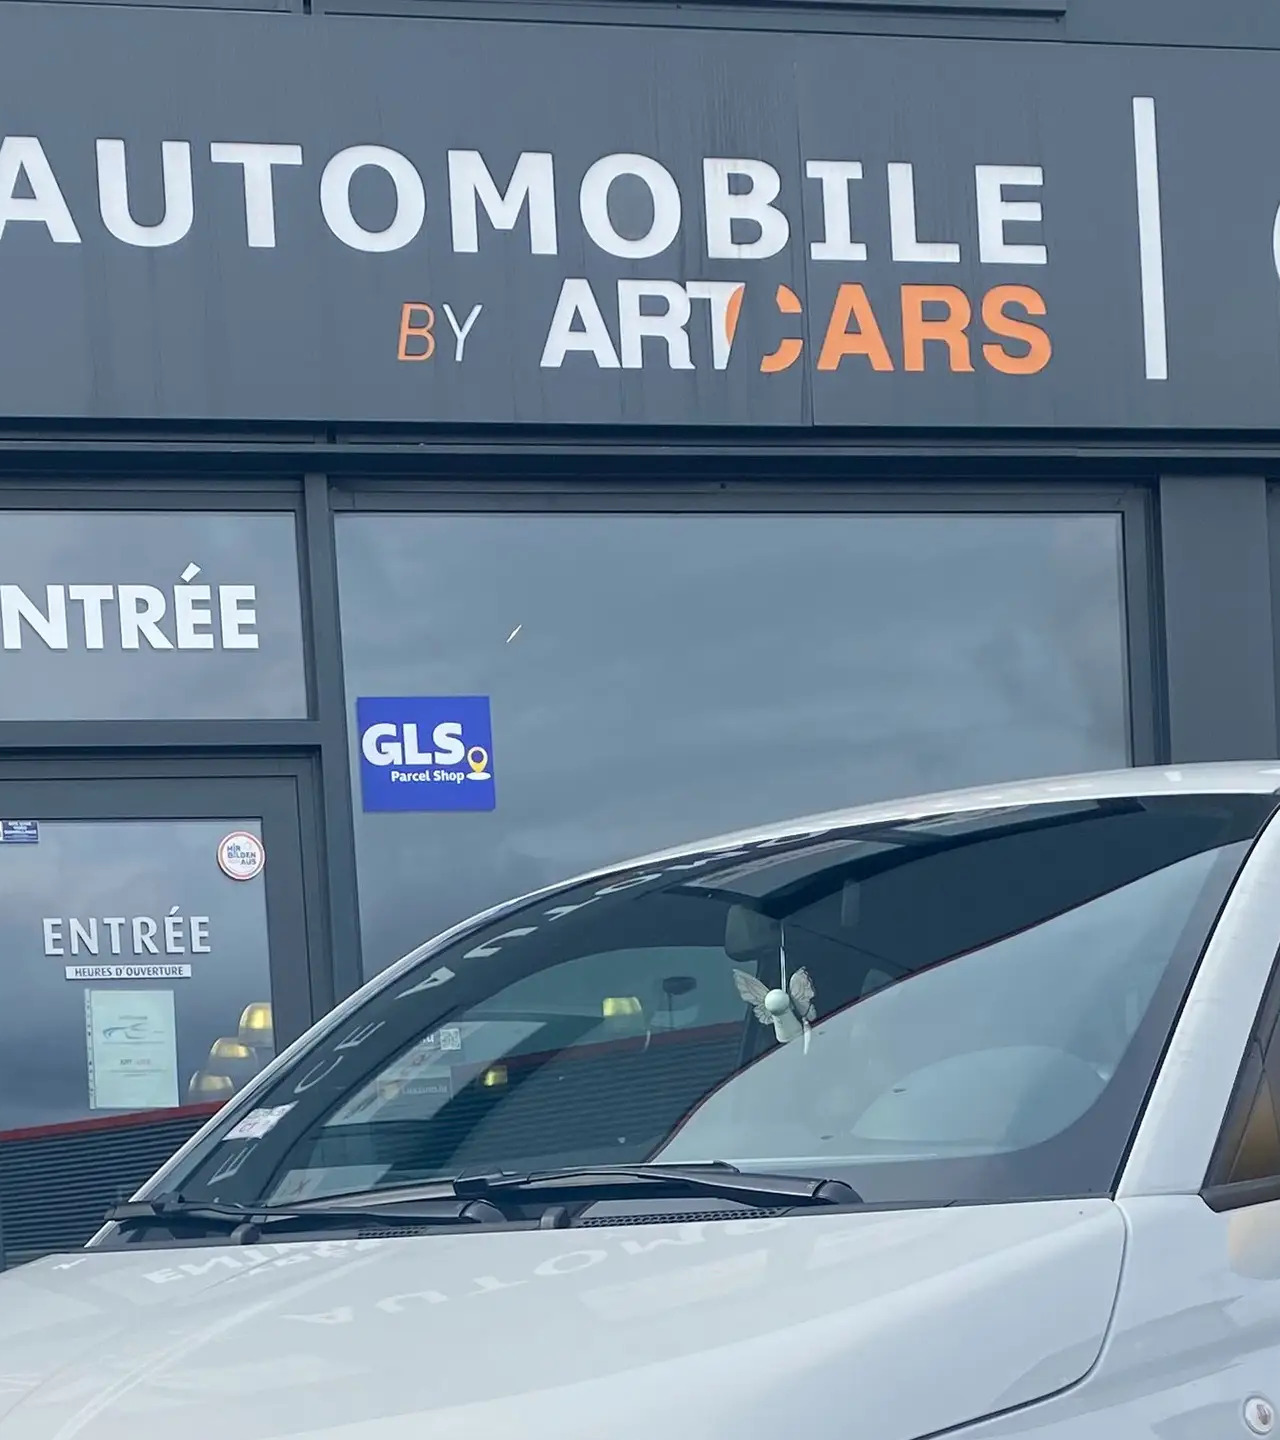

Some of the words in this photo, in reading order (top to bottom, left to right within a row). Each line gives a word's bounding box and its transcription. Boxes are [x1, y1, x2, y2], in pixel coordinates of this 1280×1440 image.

[397, 301, 482, 363] BY
[391, 769, 431, 783] Parcel
[433, 769, 465, 785] Shop
[42, 906, 211, 956] ENTRÉE
[74, 966, 112, 978] HEURES
[115, 965, 184, 977] D'OUVERTURE
